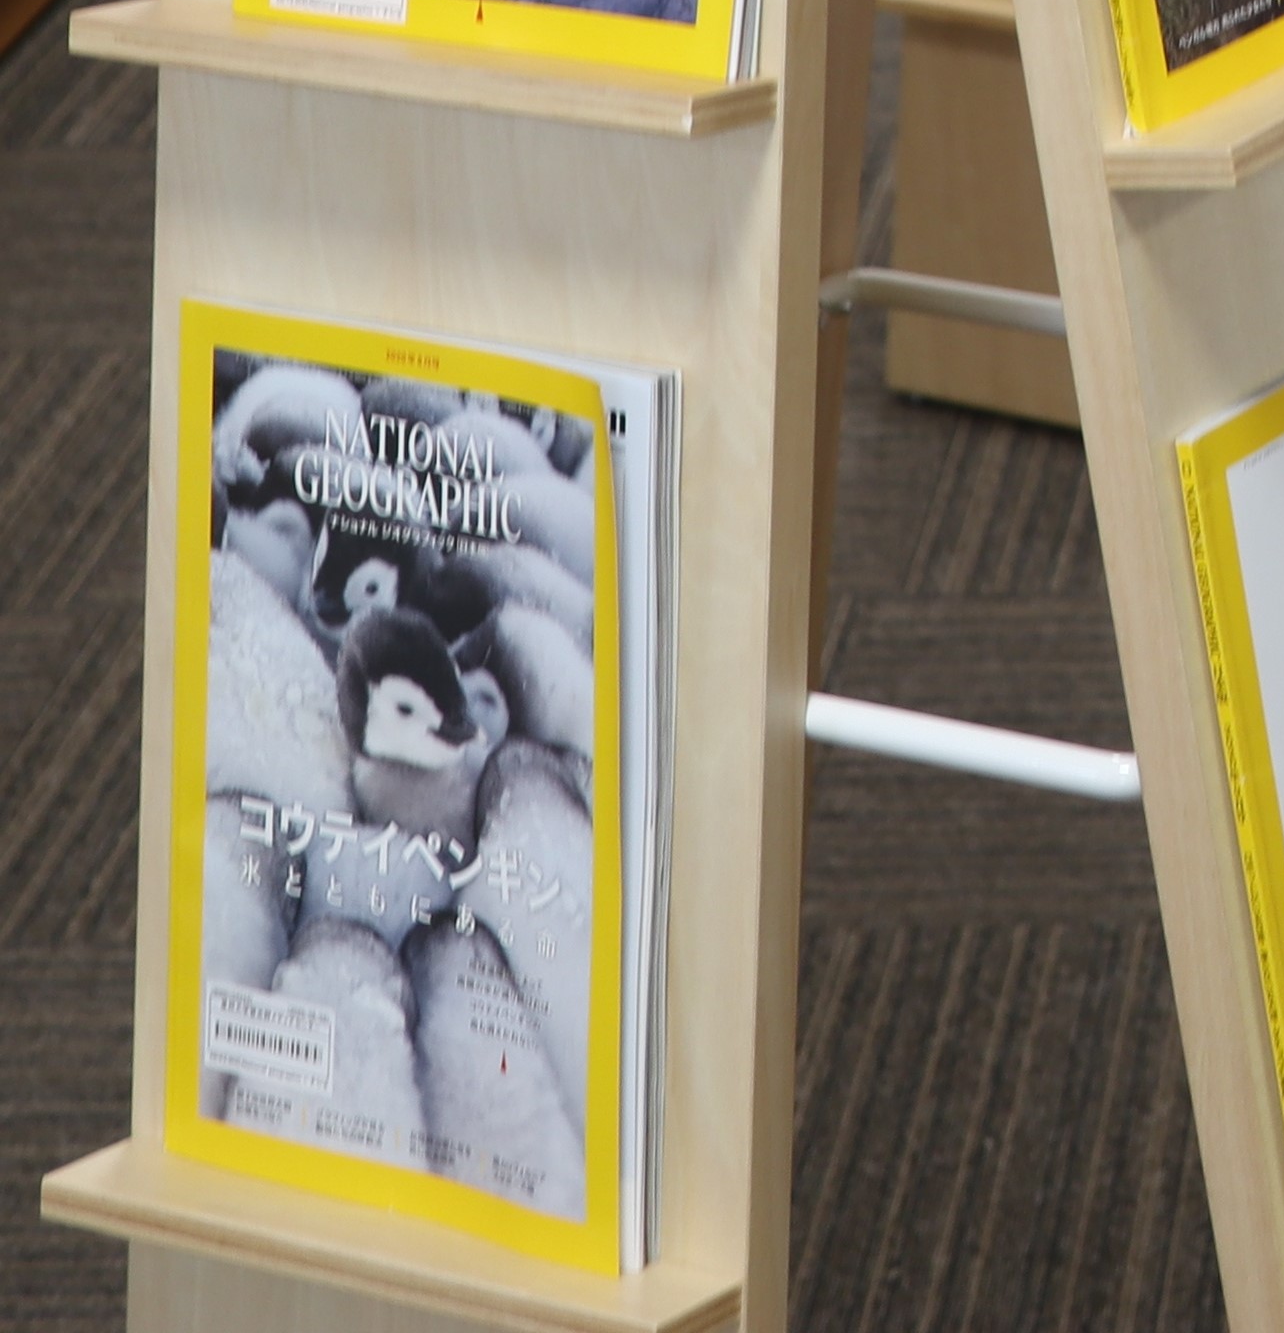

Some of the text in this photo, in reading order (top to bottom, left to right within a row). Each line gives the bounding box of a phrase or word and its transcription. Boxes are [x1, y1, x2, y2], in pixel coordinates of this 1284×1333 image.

[323, 408, 505, 484] NATIONAL
[294, 449, 523, 546] GEOGRAPHIC
[239, 794, 561, 914] コウテイペンギン
[239, 853, 558, 960] 氷とともにある命
